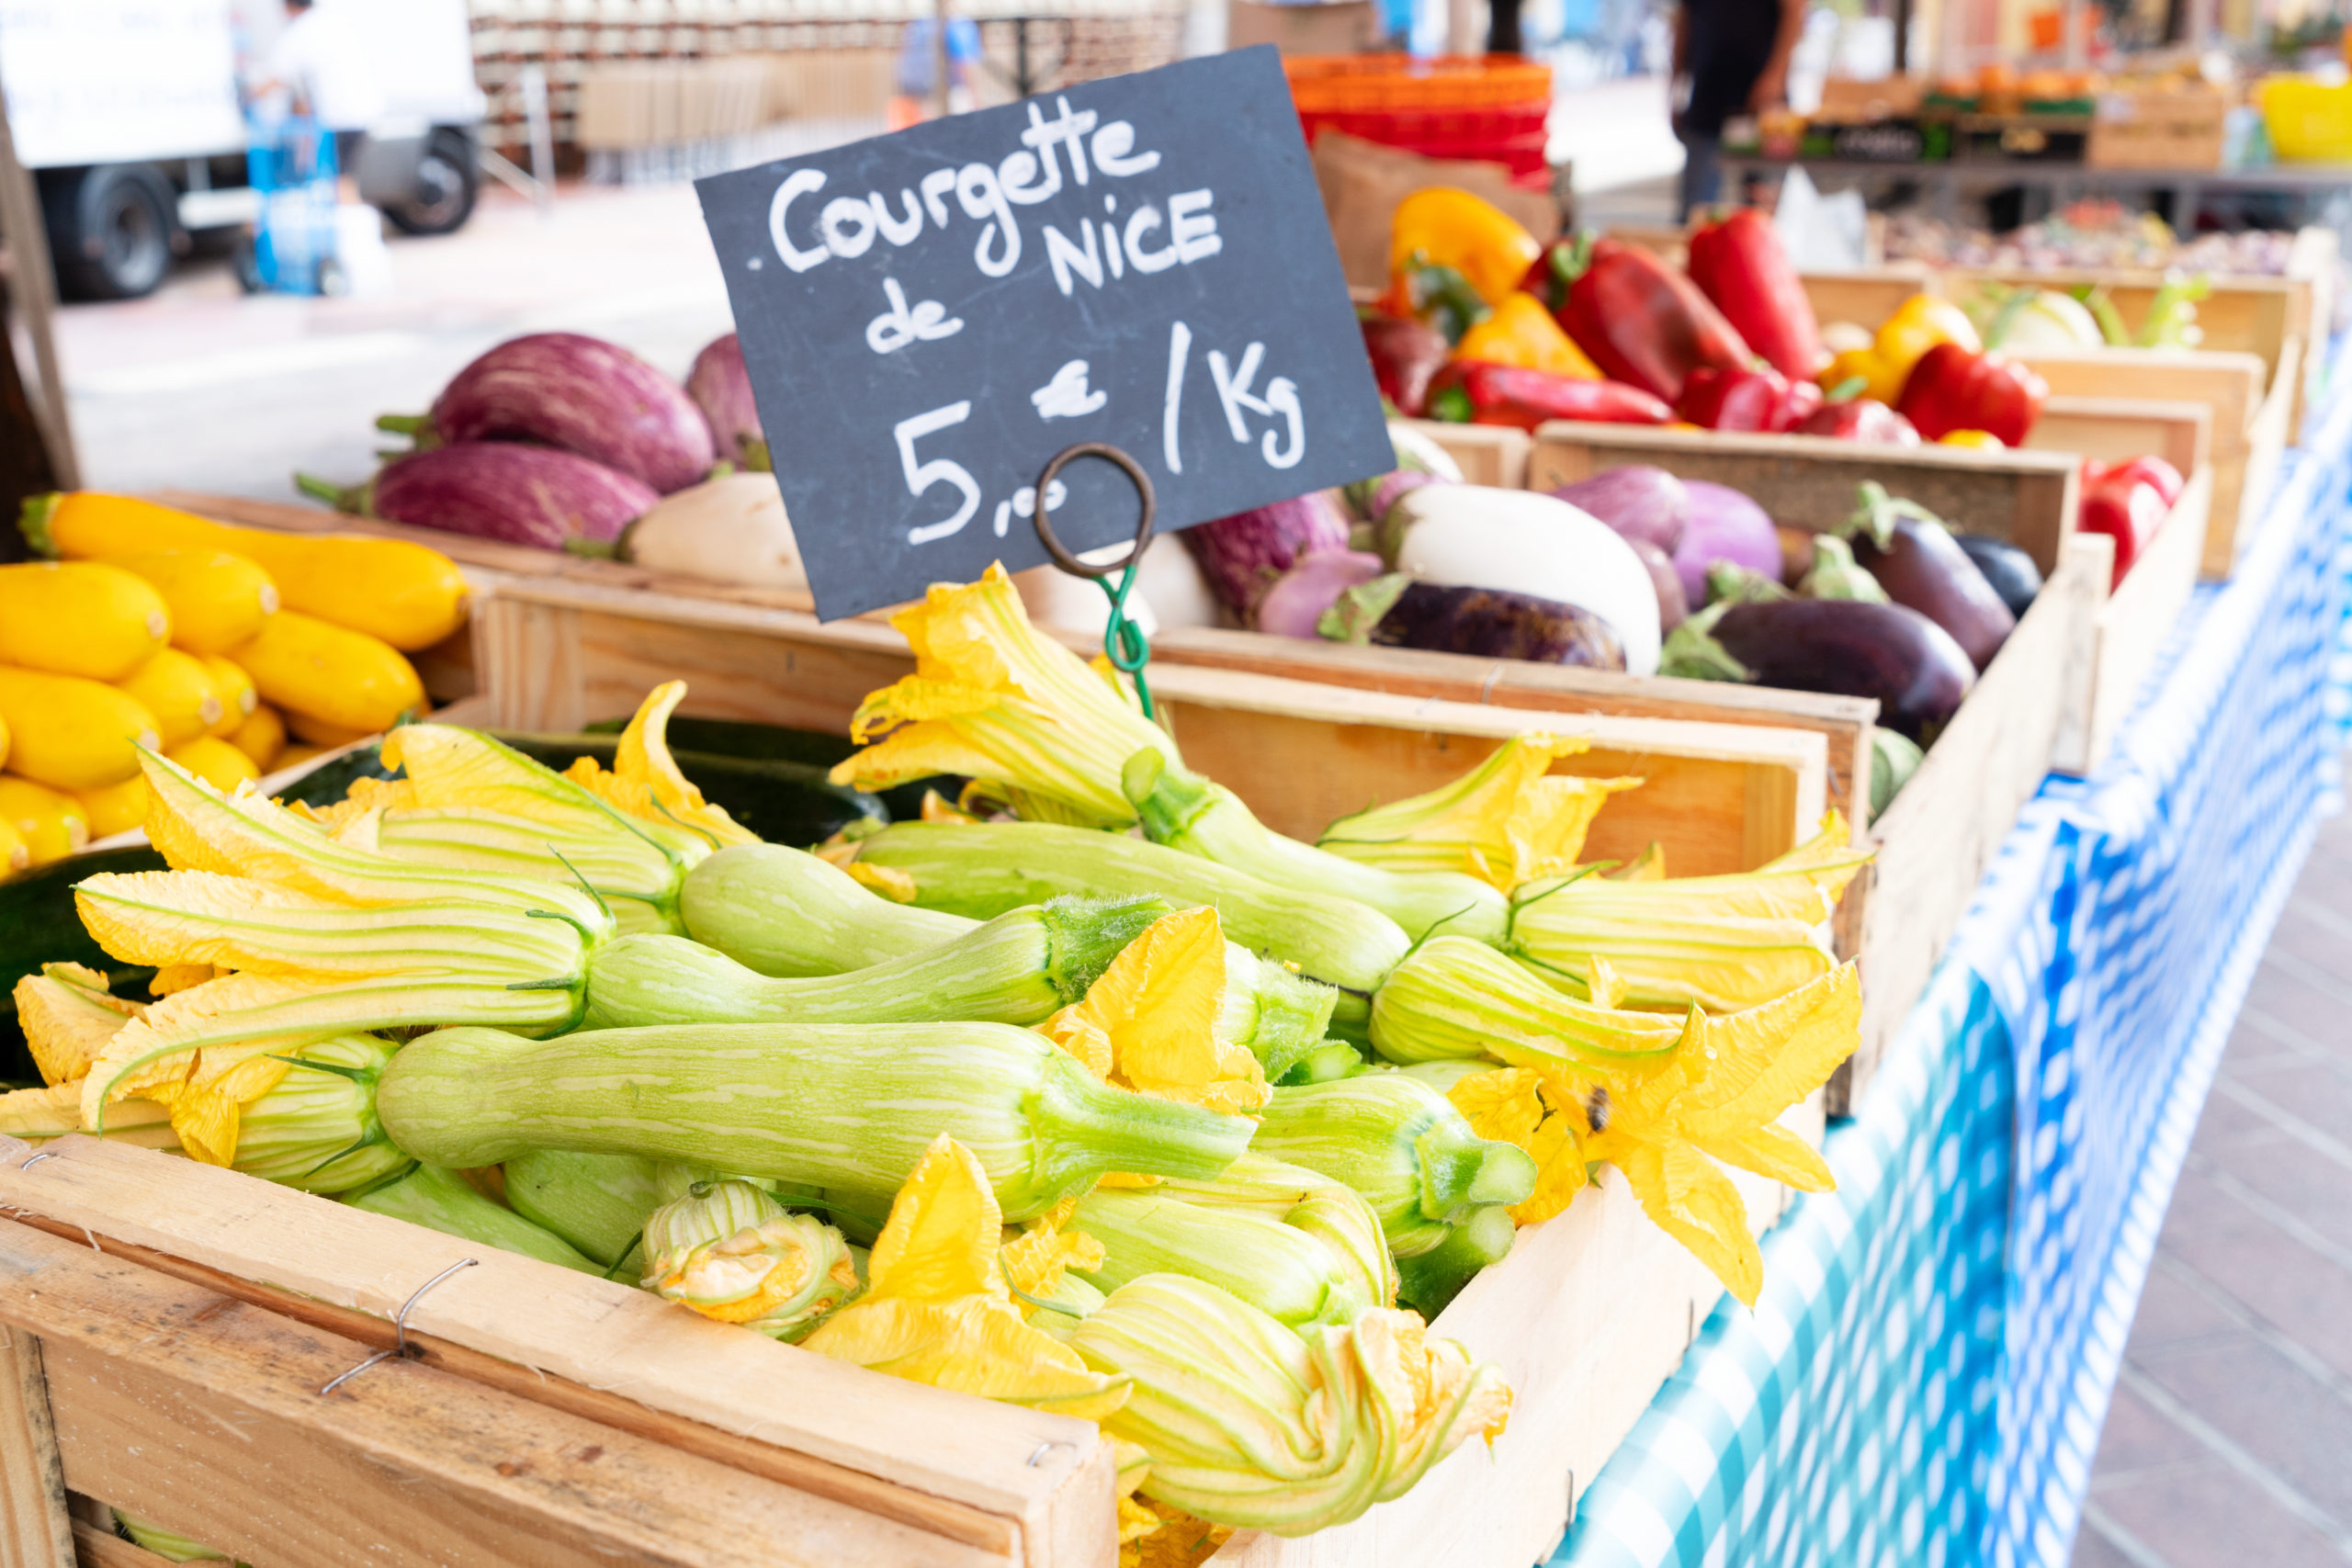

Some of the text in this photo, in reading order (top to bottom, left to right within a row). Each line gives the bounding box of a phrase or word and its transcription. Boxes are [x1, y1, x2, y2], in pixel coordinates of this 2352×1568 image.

[769, 96, 1160, 276] Courgette
[866, 277, 964, 354] de
[1030, 360, 1108, 420] €
